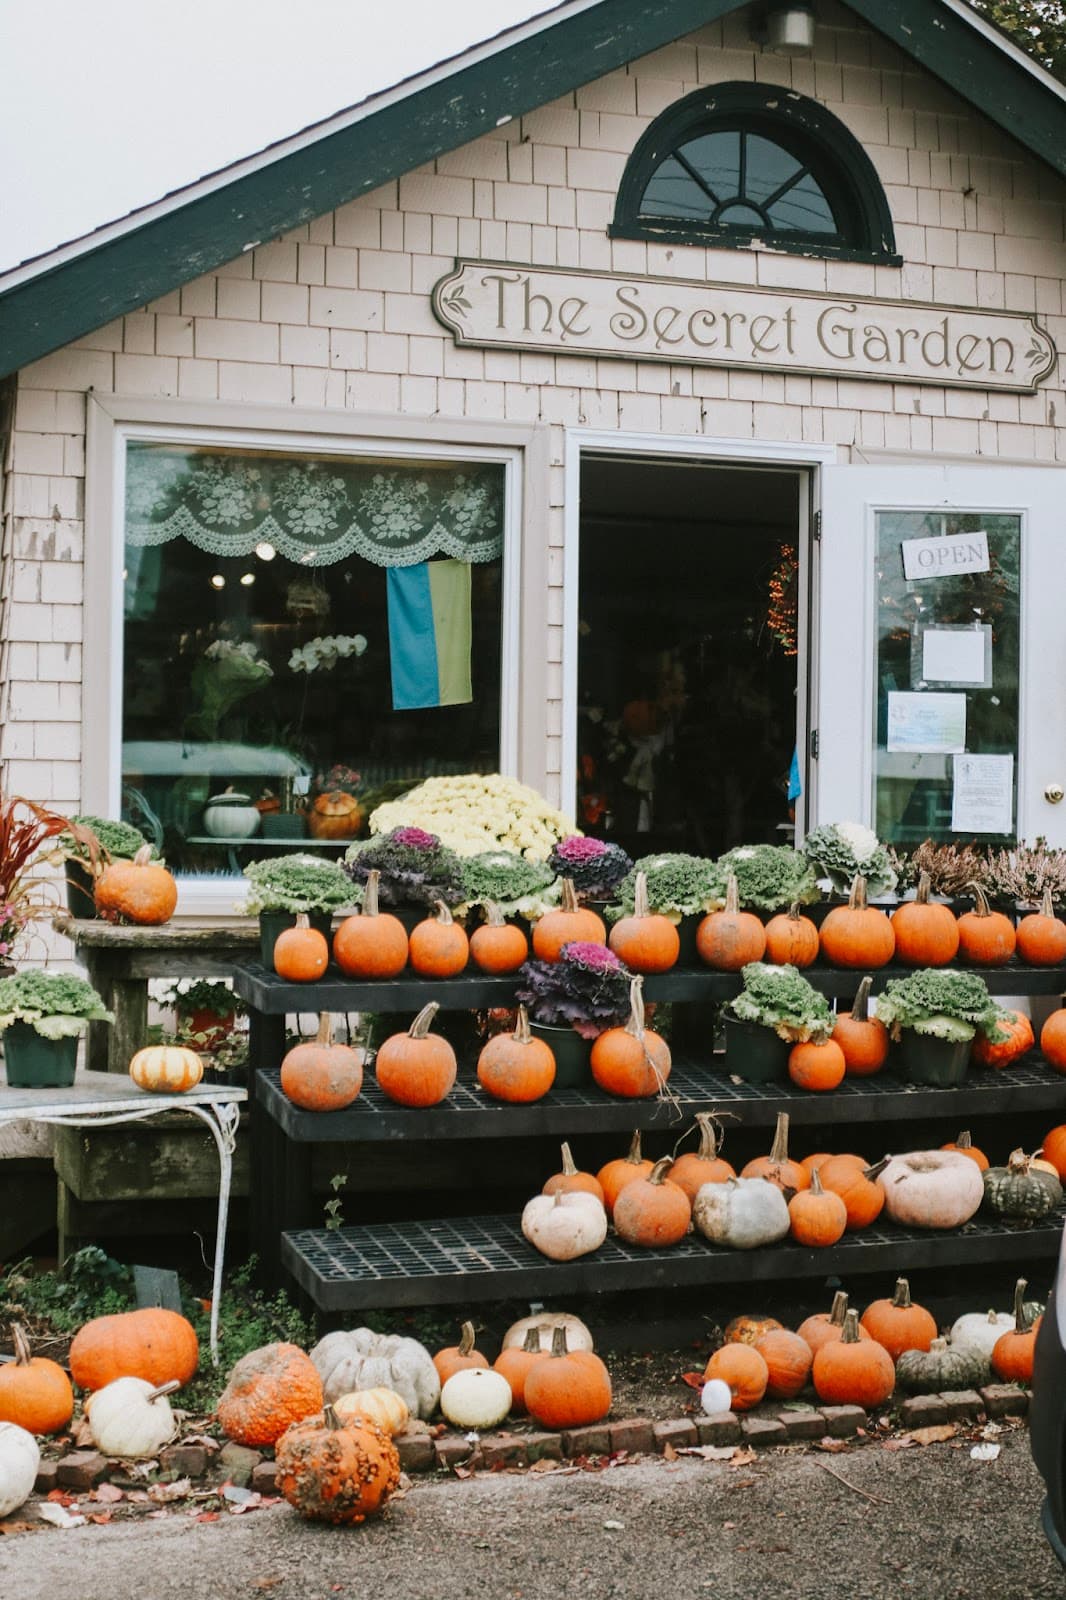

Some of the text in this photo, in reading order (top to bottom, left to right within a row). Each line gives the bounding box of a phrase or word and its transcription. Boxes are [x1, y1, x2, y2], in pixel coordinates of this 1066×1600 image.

[481, 273, 1015, 376] The Secret Garden
[918, 543, 983, 568] OPEN
